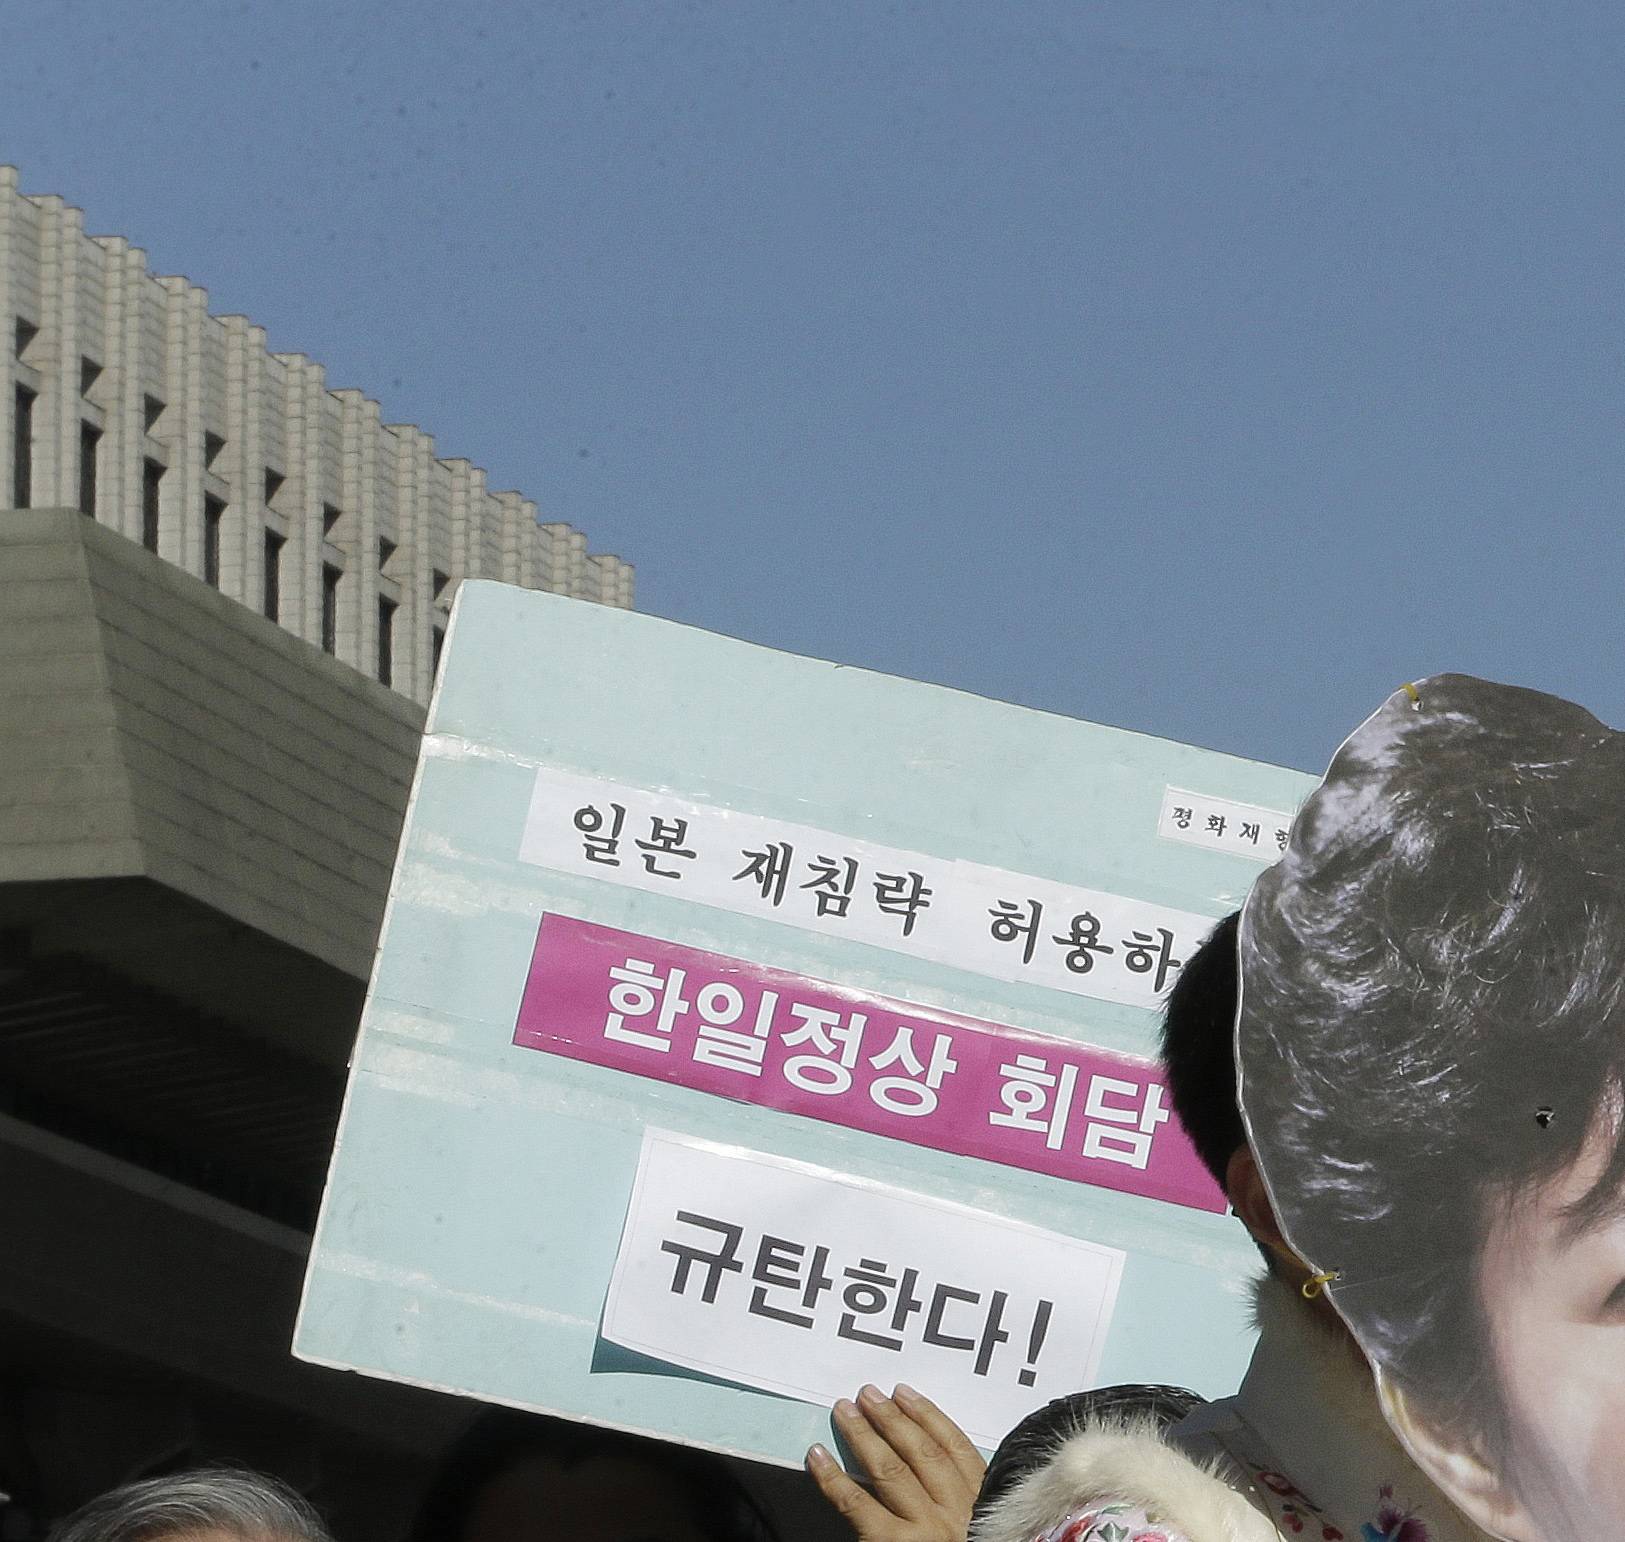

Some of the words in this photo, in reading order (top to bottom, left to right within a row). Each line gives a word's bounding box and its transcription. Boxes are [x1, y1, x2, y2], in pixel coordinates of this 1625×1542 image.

[571, 803, 697, 880] 일본
[732, 840, 933, 937] 재침략
[987, 897, 1203, 993] 허용하
[603, 957, 958, 1118] 한일정상
[988, 1053, 1170, 1170] 회담
[660, 1210, 1054, 1387] 규탄한다!
